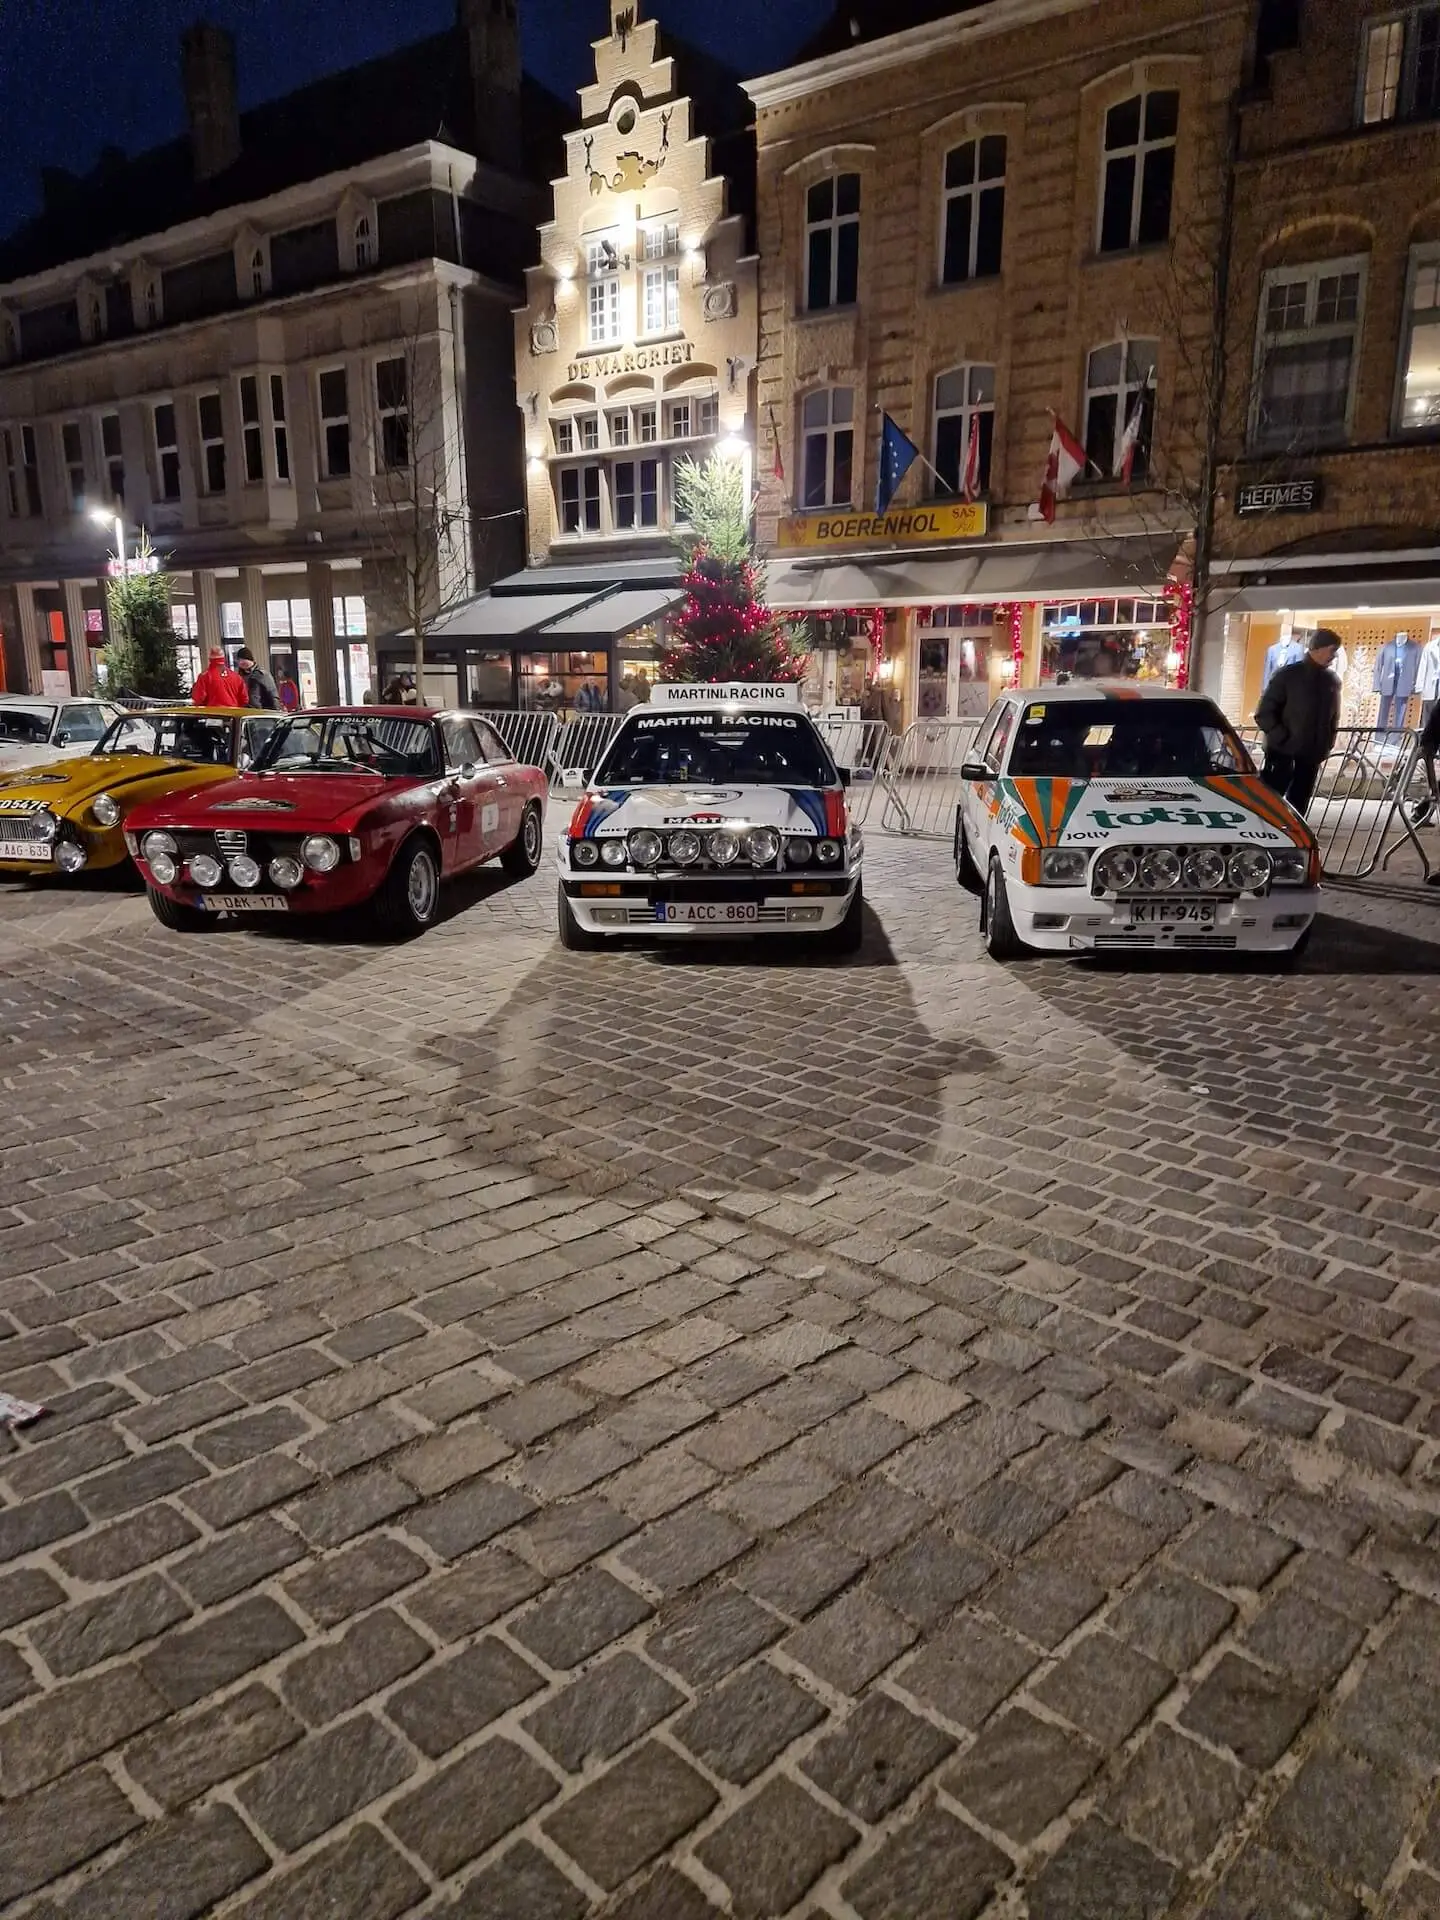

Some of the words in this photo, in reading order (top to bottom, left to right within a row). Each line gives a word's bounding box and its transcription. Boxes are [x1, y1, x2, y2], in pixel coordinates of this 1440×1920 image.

[567, 361, 590, 382] DE
[595, 342, 695, 377] MARGRIET
[1240, 485, 1313, 505] HERMES
[816, 504, 940, 540] BOERENHOL
[668, 688, 727, 700] MARTINI
[730, 687, 785, 699] RACING
[637, 716, 713, 729] MARTINI
[721, 716, 797, 728] RACING
[0, 799, 50, 811] D547F
[1086, 807, 1246, 829] totip
[1066, 831, 1110, 840] JOLLY
[1239, 831, 1280, 840] CLUB
[1135, 905, 1212, 921] KIF-945
